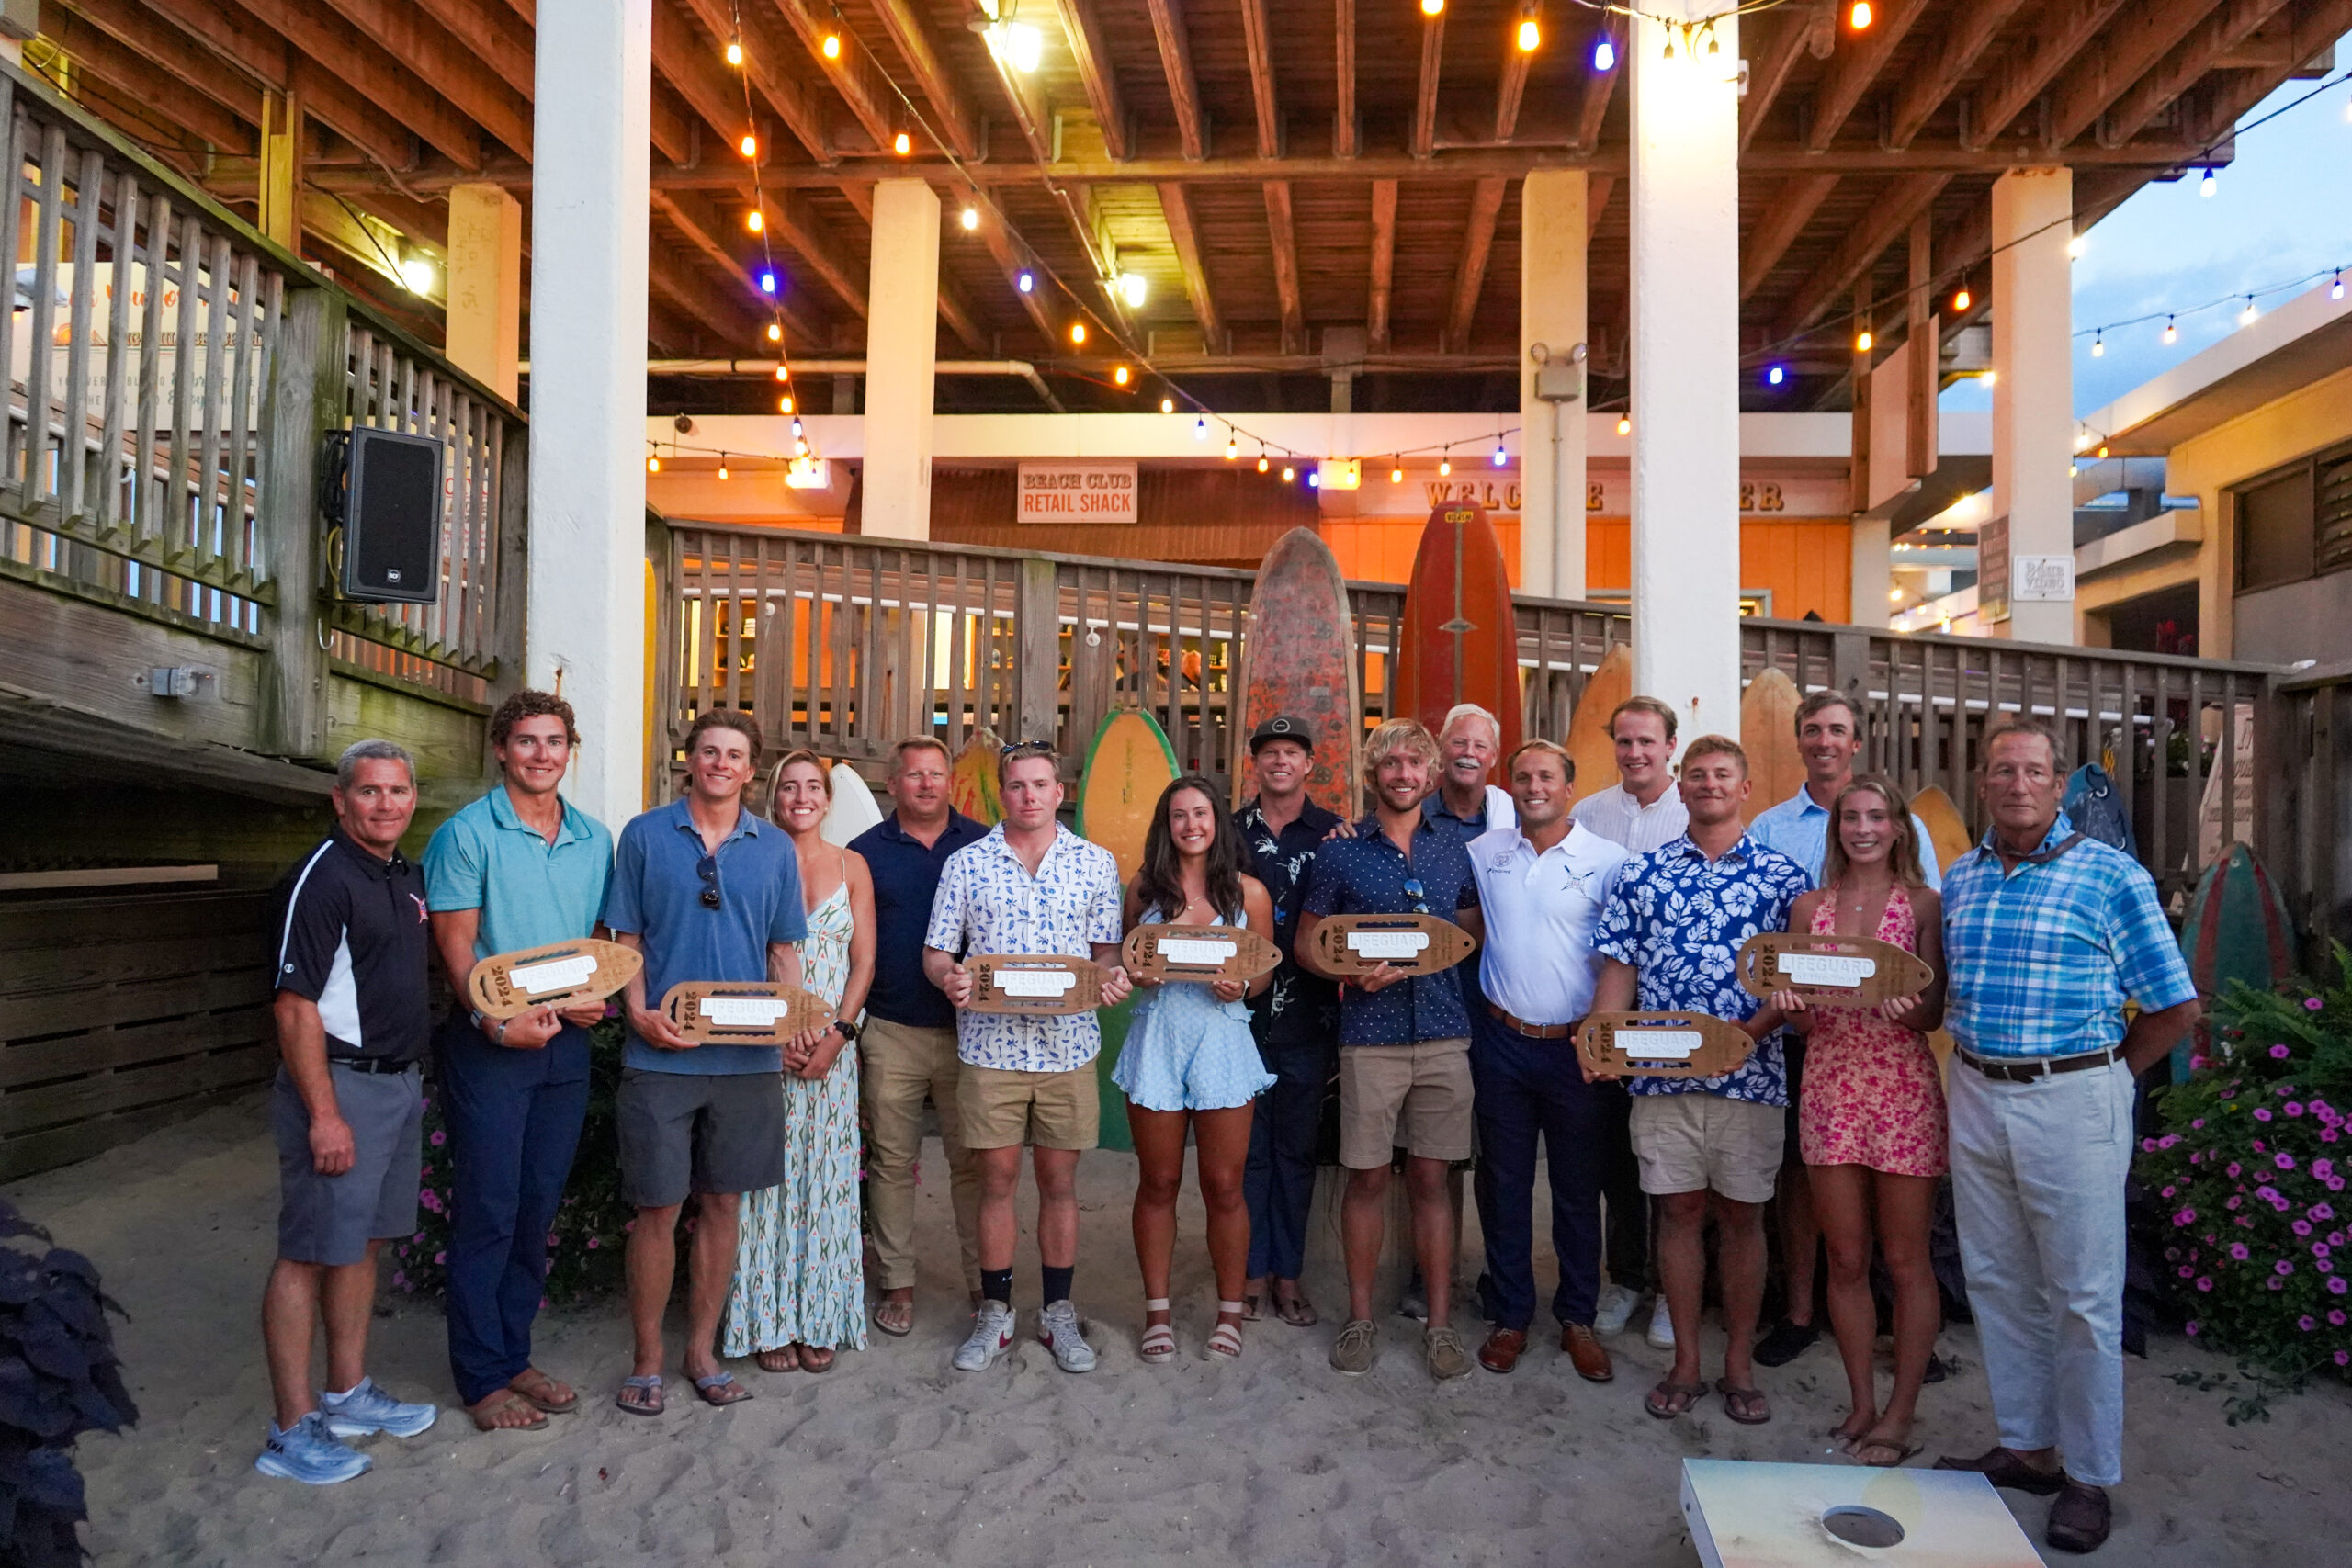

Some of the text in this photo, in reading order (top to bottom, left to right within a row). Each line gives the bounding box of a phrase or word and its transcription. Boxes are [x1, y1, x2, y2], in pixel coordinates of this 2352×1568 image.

[1023, 474, 1132, 490] BEACH CLUB
[1024, 493, 1131, 513] RETAIL SHACK
[1424, 481, 1603, 511] WELCE
[1142, 932, 1156, 967] 2024
[1160, 941, 1236, 955] LIFEGUARD
[1331, 924, 1345, 964] 2024
[1350, 933, 1428, 948] LIFEGUARD
[1761, 943, 1775, 987] 2024
[1781, 955, 1874, 976] LIFEGUARD
[492, 965, 514, 1008] 2024
[978, 964, 991, 1002] 2024
[996, 972, 1074, 987] LIFEGUARD
[684, 991, 698, 1032] 2024
[703, 1000, 786, 1016] LIFEGUARD
[1600, 1022, 1612, 1064] 2024
[1616, 1032, 1700, 1046] LIFEGUARD
